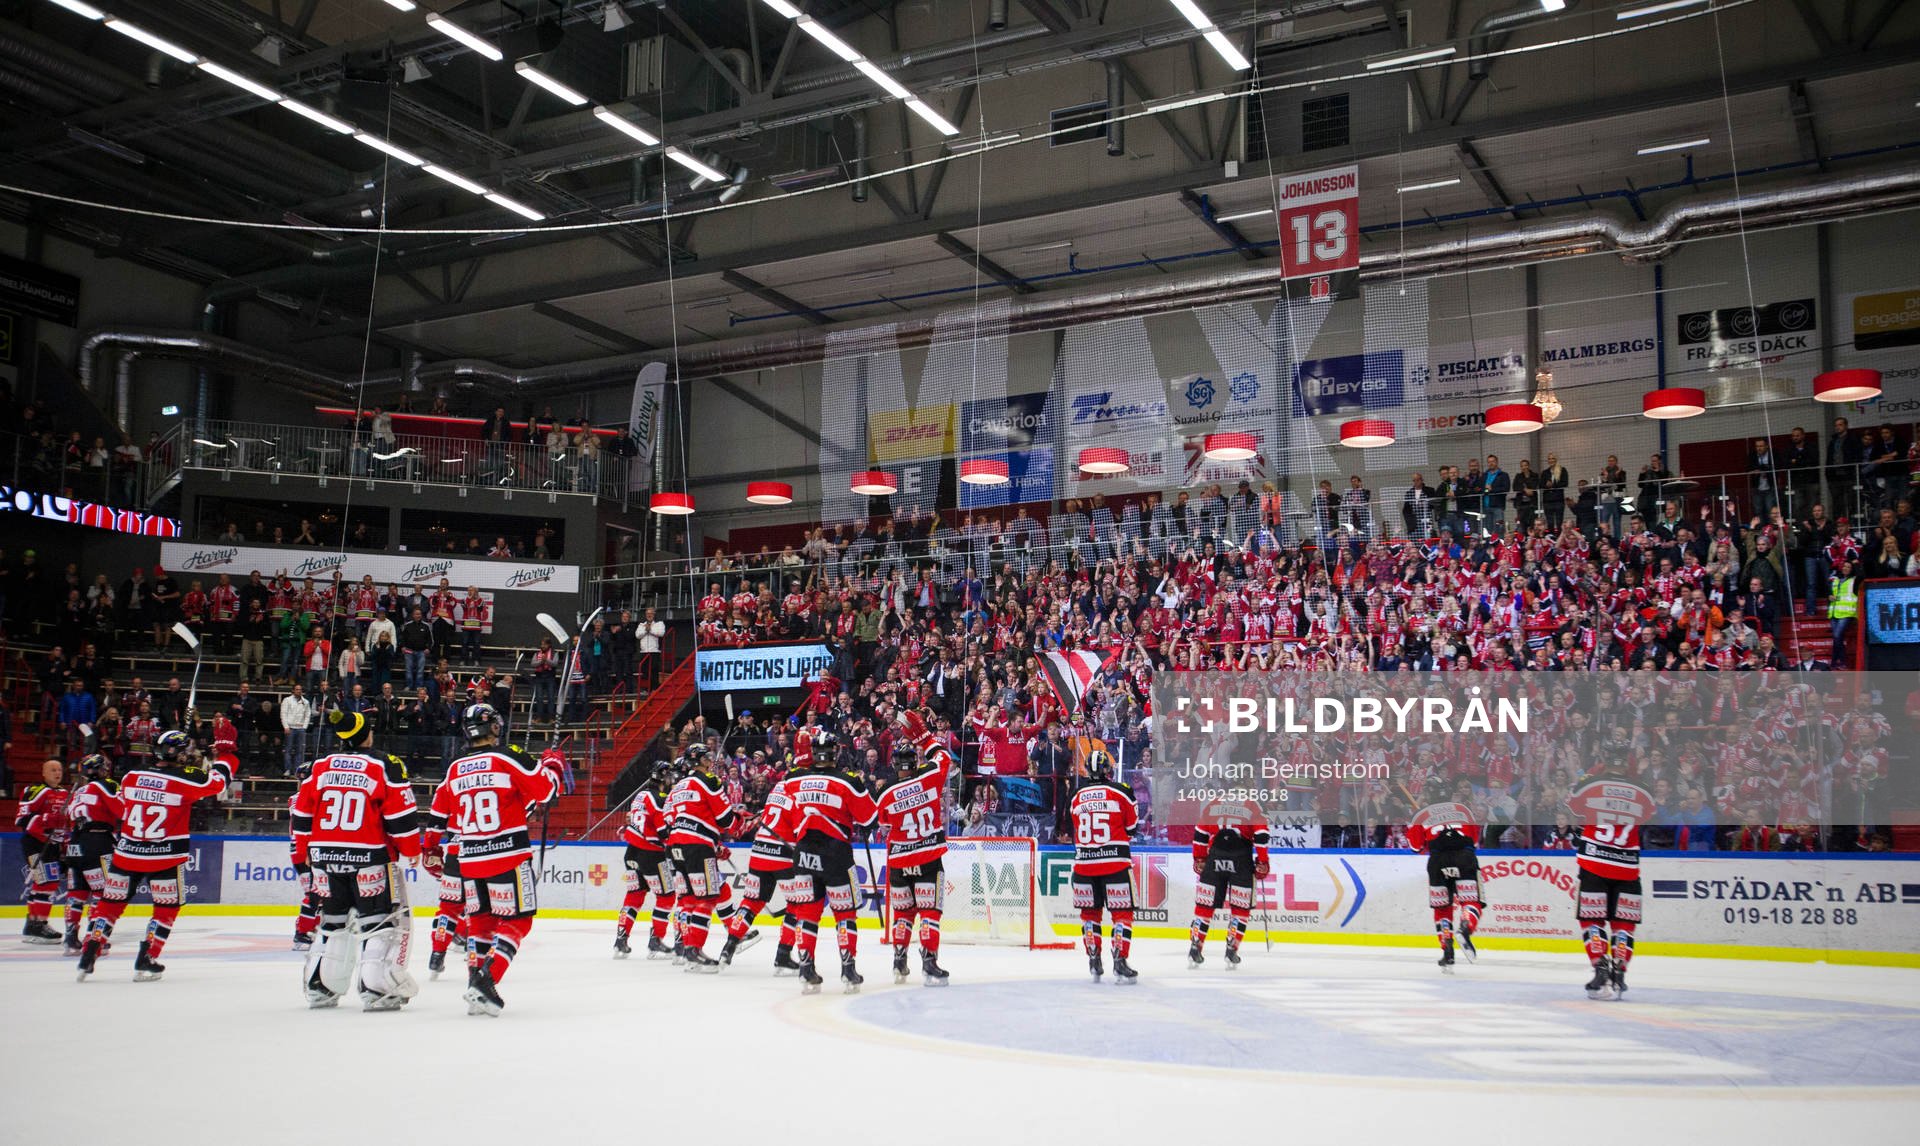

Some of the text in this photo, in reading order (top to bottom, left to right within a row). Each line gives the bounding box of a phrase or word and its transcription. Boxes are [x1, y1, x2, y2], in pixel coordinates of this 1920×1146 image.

[1281, 173, 1356, 200] JOHANSSON
[1291, 209, 1348, 265] 13
[1544, 338, 1656, 362] MALMBERGS
[1761, 335, 1808, 353] DÄCK
[1439, 370, 1504, 383] ventilation
[968, 411, 1047, 435] Caverion
[1174, 411, 1209, 426] Suzuki
[182, 547, 238, 570] Harrys
[294, 553, 347, 577] Harrys
[402, 559, 453, 583] Harrys
[505, 565, 555, 588] Harrys
[701, 658, 784, 682] MATCHENS
[325, 773, 369, 789] UNDBERG
[320, 790, 367, 832] 30
[460, 791, 501, 834] 28
[893, 793, 931, 813] ERIKSSON
[127, 804, 169, 839] 42
[900, 806, 936, 840] 40
[1077, 813, 1111, 845] 85
[1595, 812, 1636, 847] 57
[798, 851, 824, 872] NA
[1214, 859, 1237, 873] NA
[106, 878, 129, 889] MAXI
[152, 884, 177, 894] MAXI
[915, 887, 935, 896] MAXI
[1107, 889, 1130, 897] MAXI
[1856, 882, 1898, 904] AB
[490, 889, 514, 900] MAXI
[1133, 910, 1167, 921] REBRO
[1275, 914, 1320, 924] LOGISTIC
[1492, 904, 1550, 913] SVERIGE AB
[1724, 907, 1859, 925] 019-18 28 88
